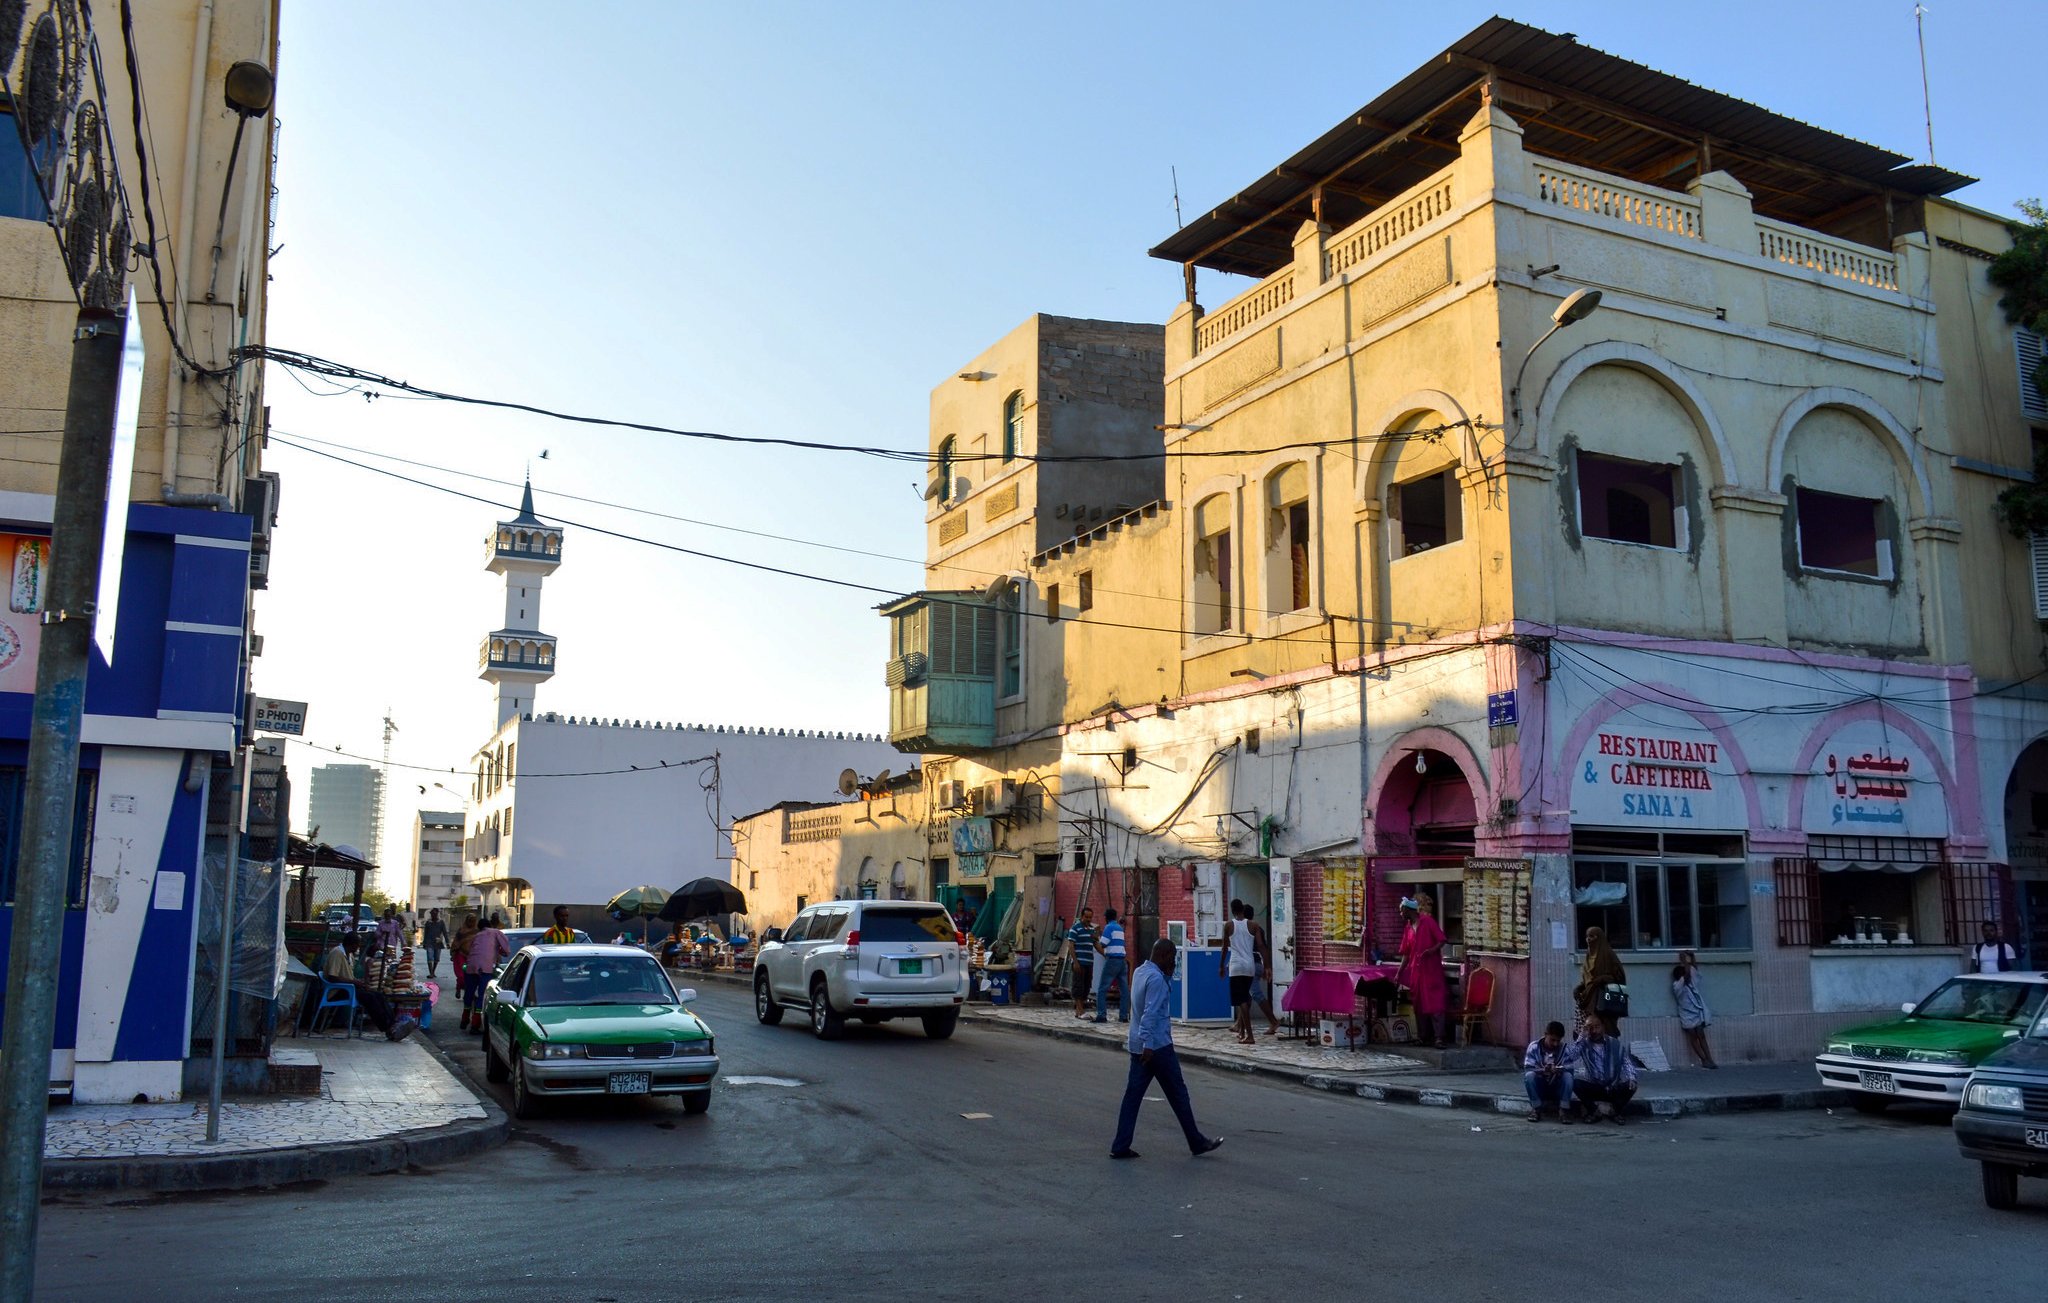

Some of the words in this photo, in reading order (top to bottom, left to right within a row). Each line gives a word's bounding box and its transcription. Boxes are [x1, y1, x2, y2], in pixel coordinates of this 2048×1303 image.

[255, 720, 272, 730] ER
[274, 722, 301, 733] CAFE
[266, 709, 301, 722] PHOTO
[1598, 733, 1717, 763] RESTAURANT
[1847, 746, 1909, 776] مطعم
[1584, 760, 1598, 784] &
[1611, 763, 1712, 790] CAFETERIA
[1824, 754, 1837, 777] و
[1623, 793, 1693, 818] SANA'A
[1832, 798, 1904, 826] صنعاء
